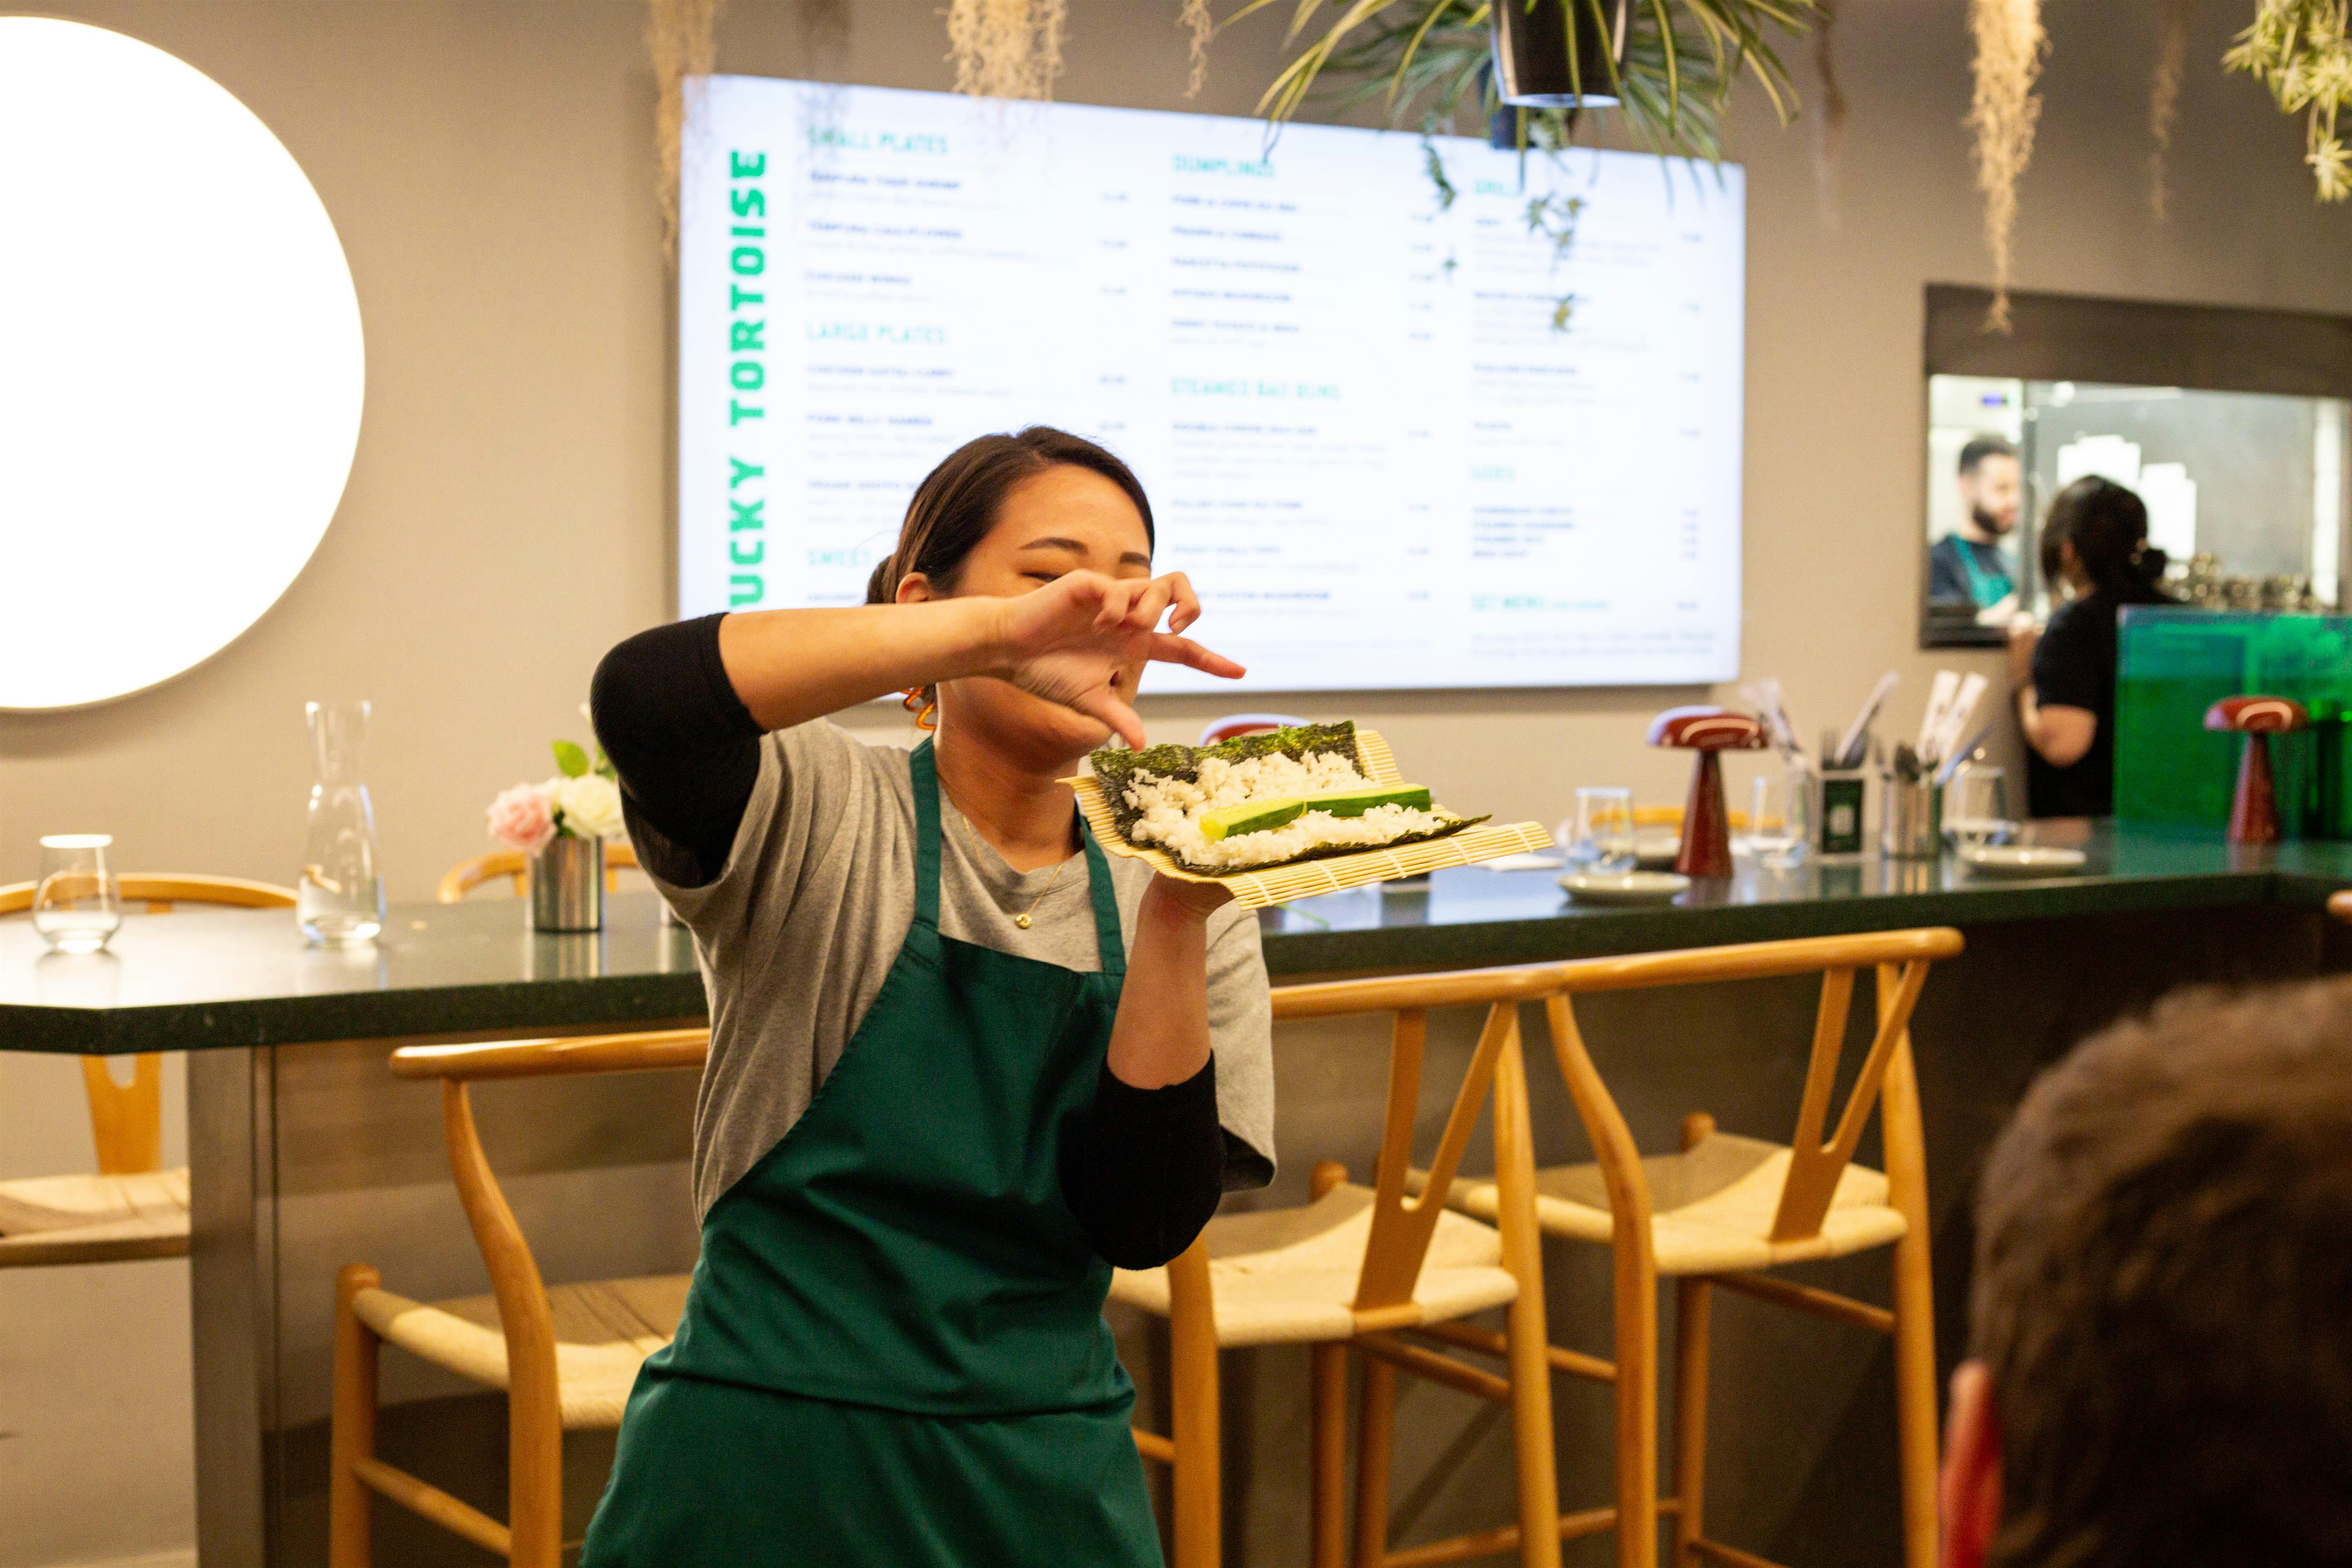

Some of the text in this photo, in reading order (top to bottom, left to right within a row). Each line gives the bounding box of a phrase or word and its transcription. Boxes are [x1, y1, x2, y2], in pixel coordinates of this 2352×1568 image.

[880, 132, 947, 155] PLATES
[1172, 154, 1275, 178] DUMPLINGS
[805, 320, 946, 345] LARGE PLATES
[729, 150, 765, 607] UCKY TORTOISE
